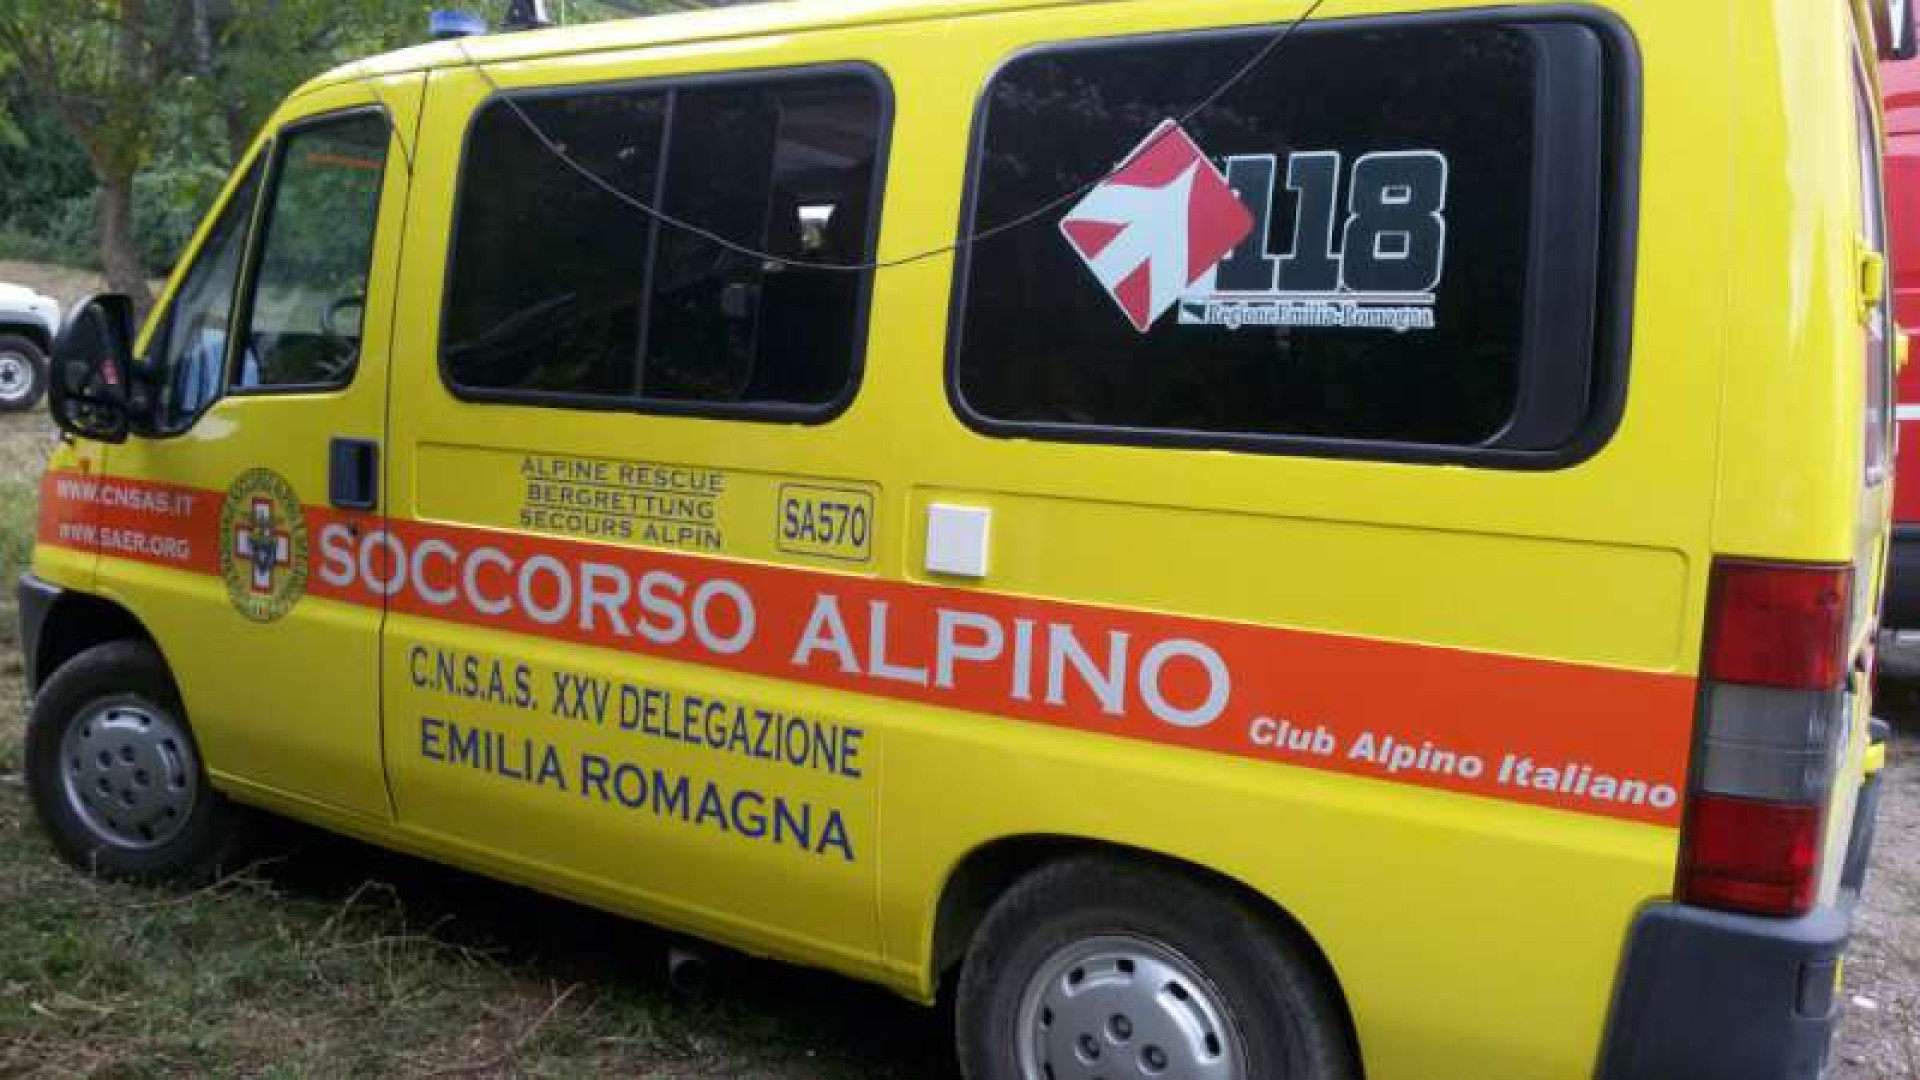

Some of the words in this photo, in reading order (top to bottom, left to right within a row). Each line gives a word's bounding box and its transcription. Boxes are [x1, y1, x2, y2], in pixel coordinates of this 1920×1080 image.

[1215, 150, 1447, 293] 118
[520, 456, 607, 481] ALPINE
[619, 463, 725, 493] RESCUE
[527, 482, 714, 519] BERGRETTUNG
[520, 507, 632, 538] SECOURS
[643, 521, 722, 549] ALPIN
[783, 498, 866, 548] SA570
[318, 523, 757, 655] SOCCORSO
[790, 592, 1231, 728] ALPINO
[409, 645, 538, 711] C.N.S.A.S.
[551, 671, 613, 725] XXV
[619, 685, 865, 779] DELEGAZIONE
[421, 716, 569, 791] EMILIA
[580, 752, 856, 862] ROMAGNA
[1249, 716, 1335, 757] Club
[1348, 731, 1484, 779] Alpino
[1497, 754, 1678, 810] Italiano
